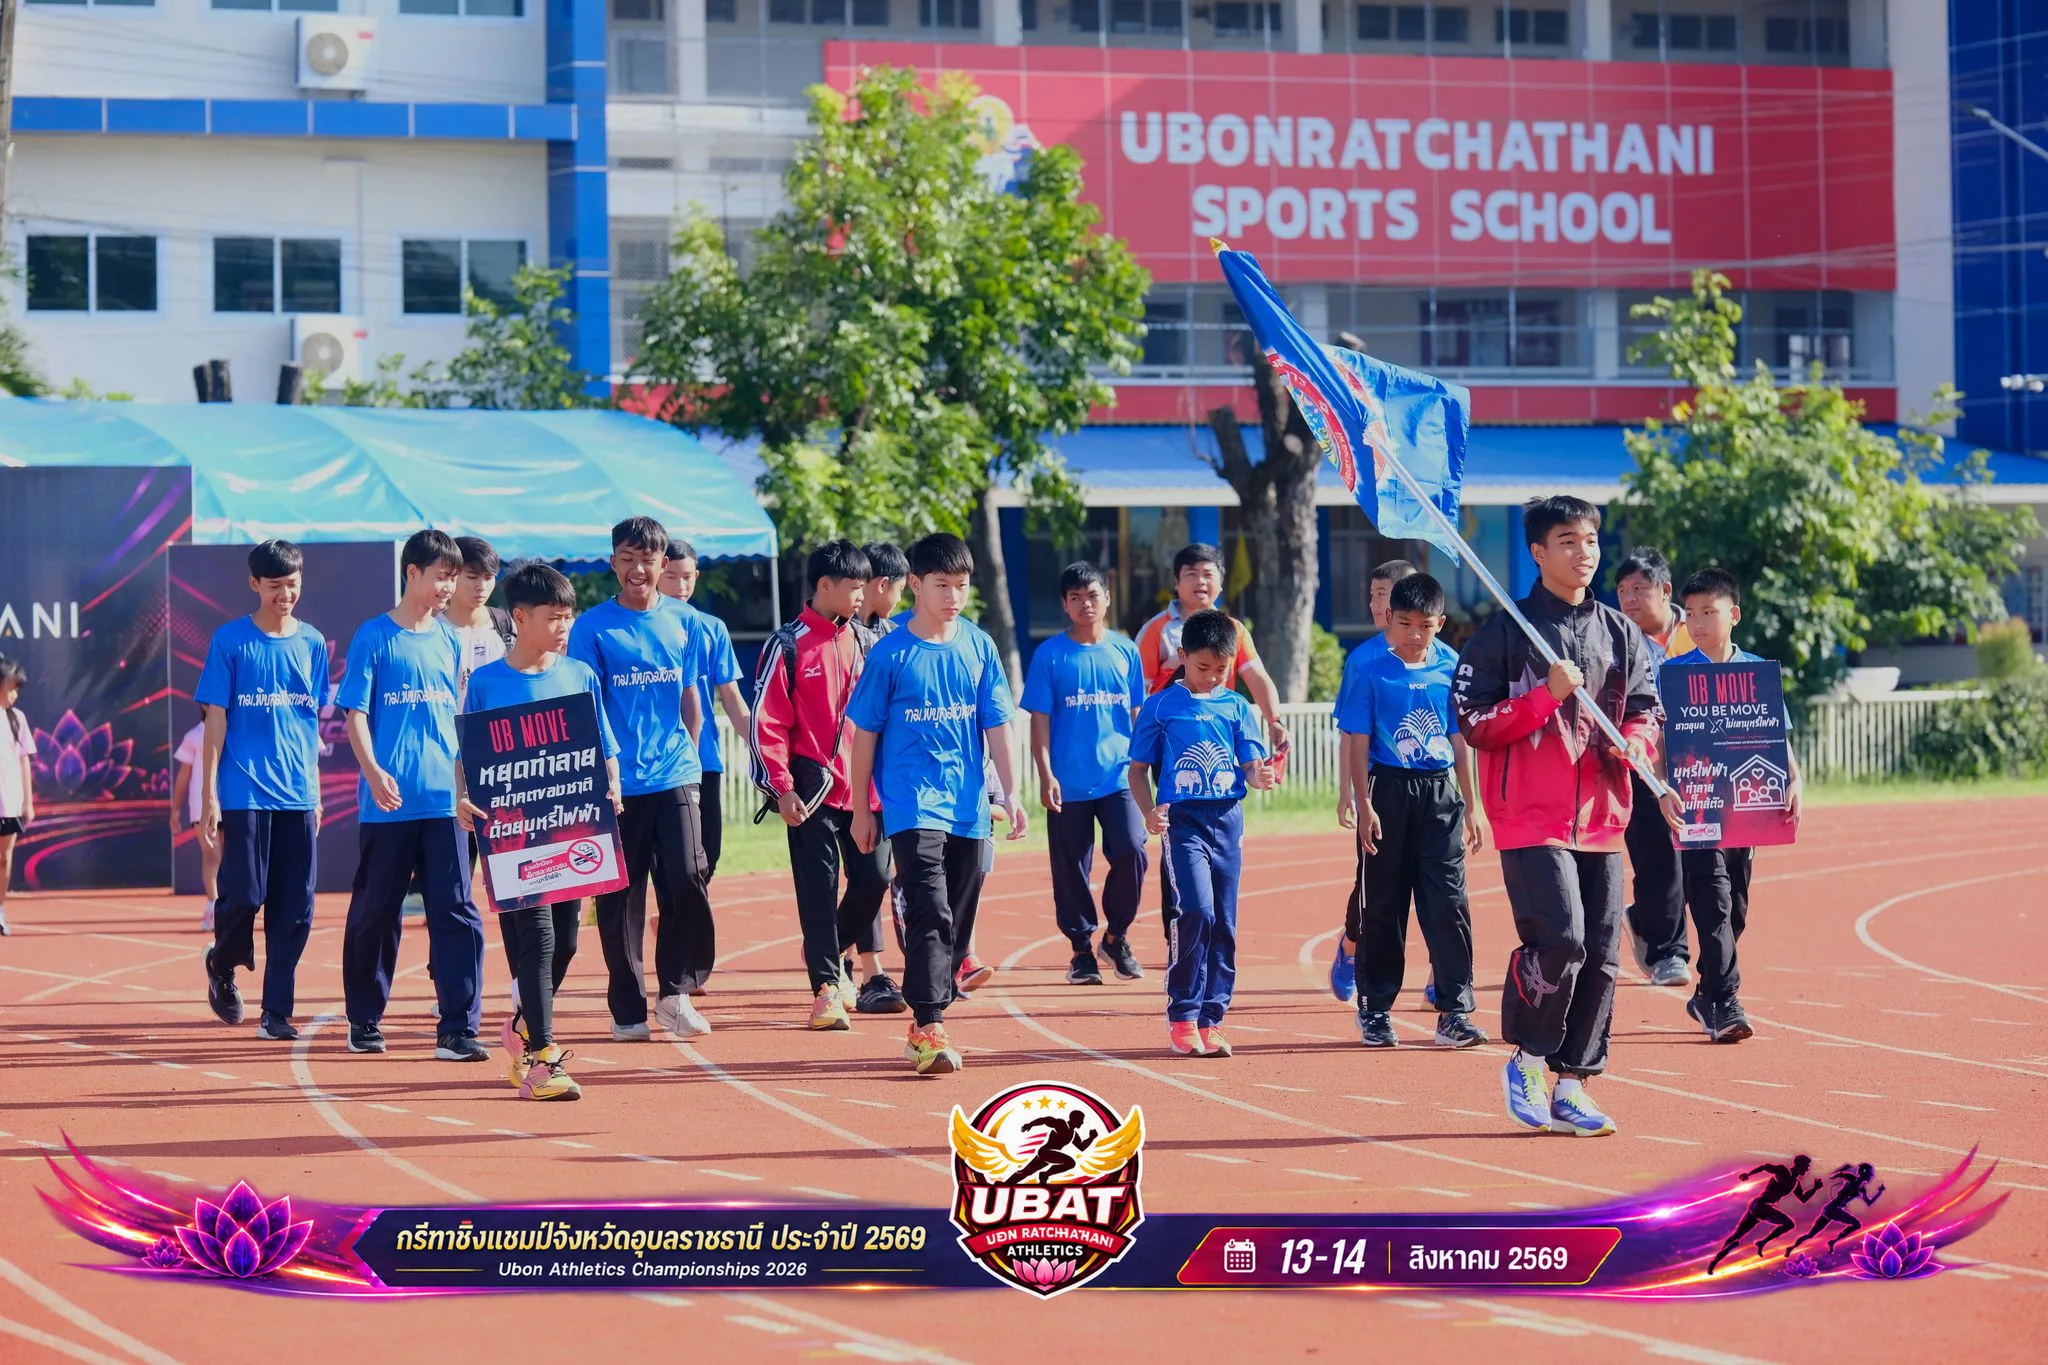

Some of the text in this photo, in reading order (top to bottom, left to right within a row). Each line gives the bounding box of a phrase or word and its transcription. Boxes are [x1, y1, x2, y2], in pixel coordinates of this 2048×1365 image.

[1121, 110, 1715, 176] UBONRATCHATHANI
[1193, 184, 1672, 244] SPORTS SCHOOL
[1688, 674, 1708, 705] UB
[1716, 671, 1757, 704] MOVE
[1675, 721, 1705, 733] ชาวอุบล
[1680, 703, 1768, 718] YOU BE MOVE
[489, 708, 570, 753] UB MOVE
[479, 746, 597, 794] หยุดทำลาย
[1673, 759, 1728, 784] บุหรี่ไฟฟ้า
[490, 776, 593, 809] อนาคตของชาติ
[1685, 780, 1714, 795] ทำลาย
[489, 803, 600, 841] ด้วยบุหรี่ไฟฟ้า
